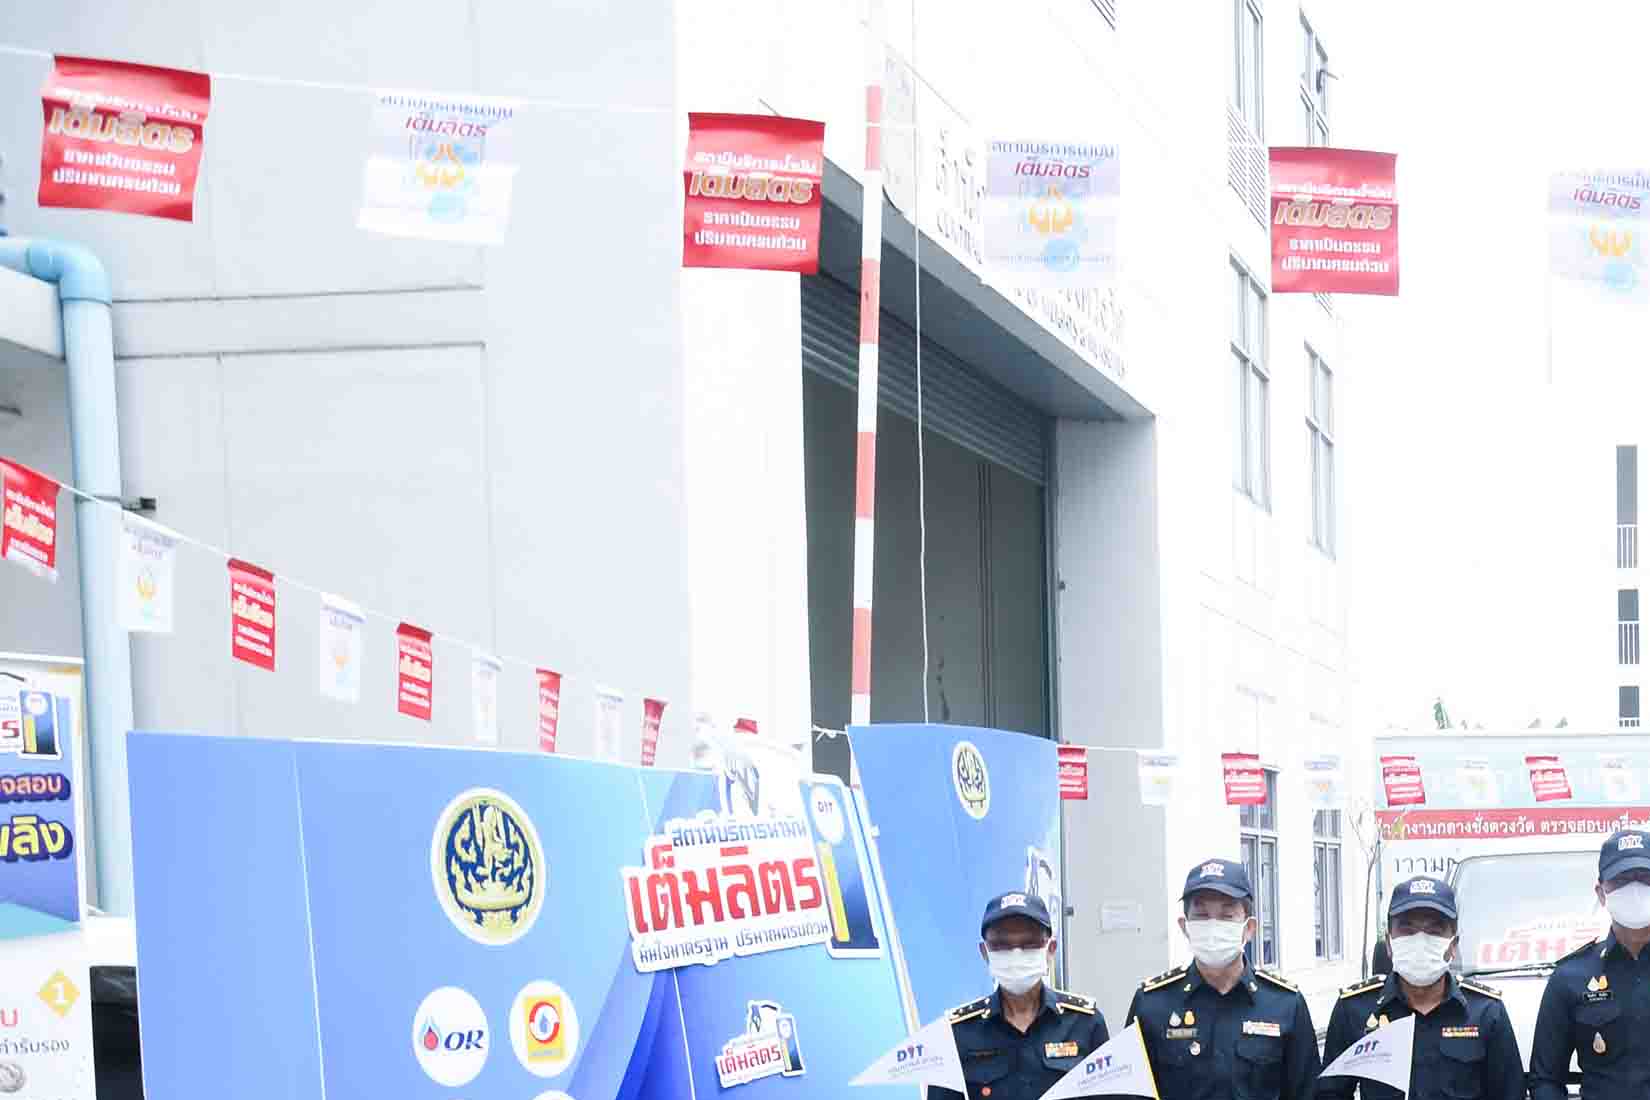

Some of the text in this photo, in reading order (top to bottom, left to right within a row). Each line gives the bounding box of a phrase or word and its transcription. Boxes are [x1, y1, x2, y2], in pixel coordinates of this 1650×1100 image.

[628, 843, 822, 934] เต็มลิตร
[444, 1029, 485, 1051] OR
